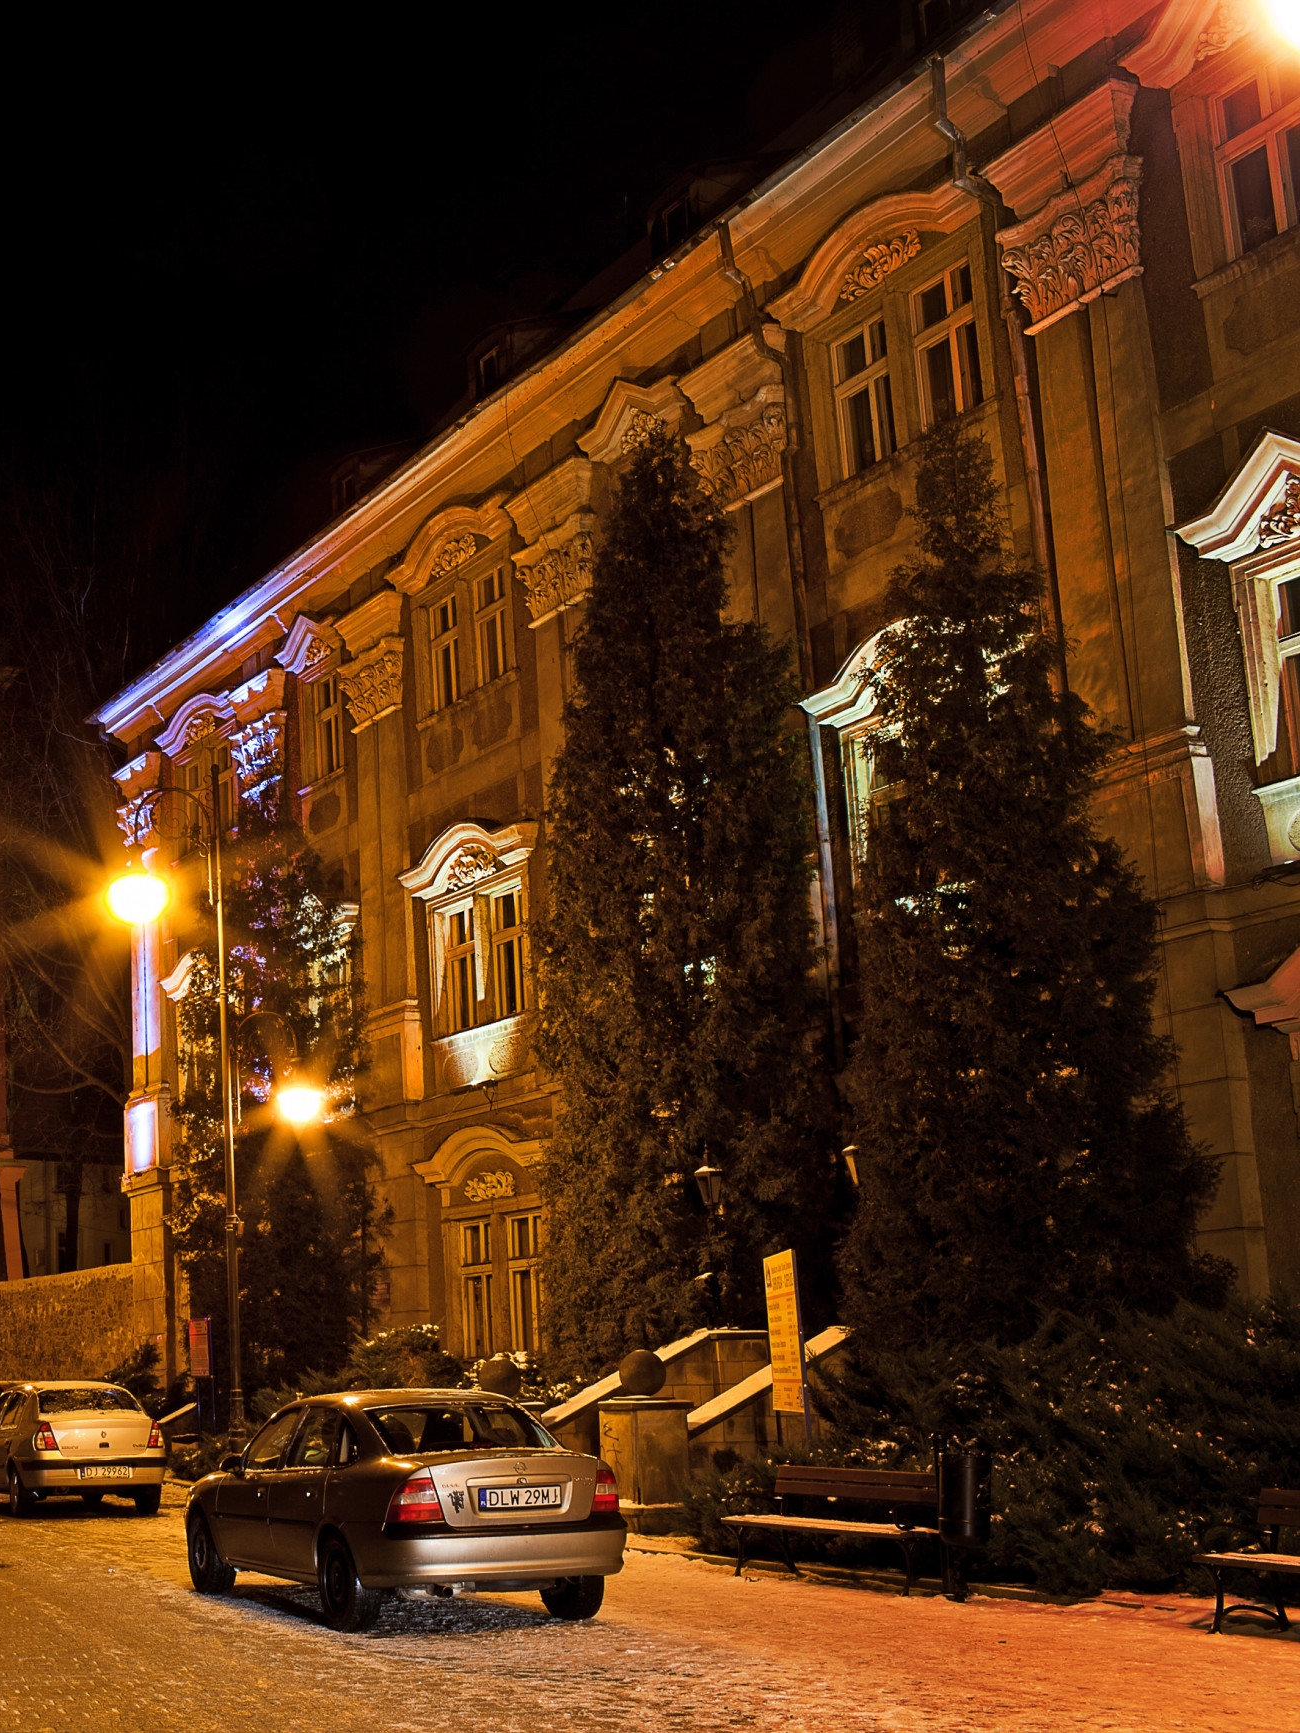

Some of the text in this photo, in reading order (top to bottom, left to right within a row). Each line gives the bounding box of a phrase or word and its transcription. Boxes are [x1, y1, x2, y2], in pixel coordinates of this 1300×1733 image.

[86, 1465, 128, 1477] DJ 29962
[489, 1488, 558, 1506] DLW 29MJ
